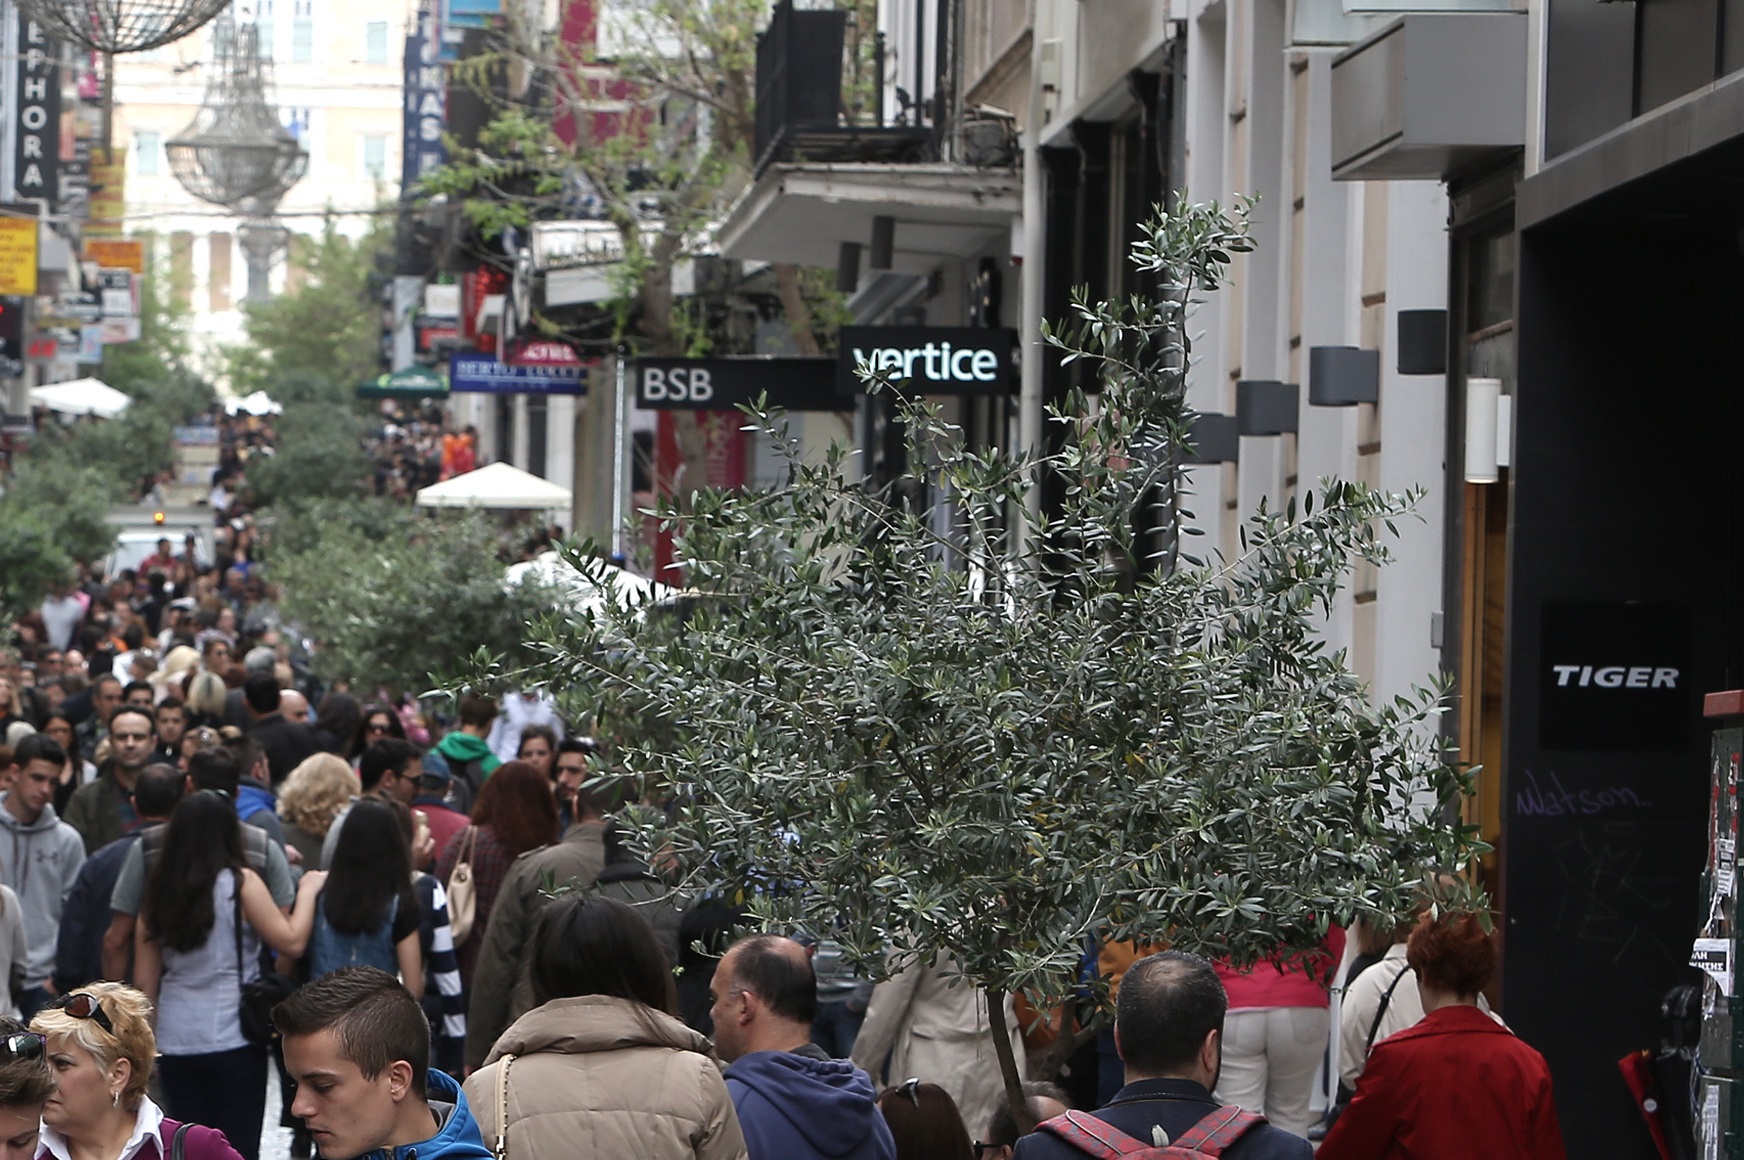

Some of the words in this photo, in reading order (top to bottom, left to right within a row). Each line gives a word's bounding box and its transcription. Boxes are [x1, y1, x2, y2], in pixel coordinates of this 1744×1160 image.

[21, 18, 48, 188] EPHORA
[853, 341, 998, 381] vertice
[643, 368, 712, 400] BSB
[1552, 665, 1680, 688] TIGER
